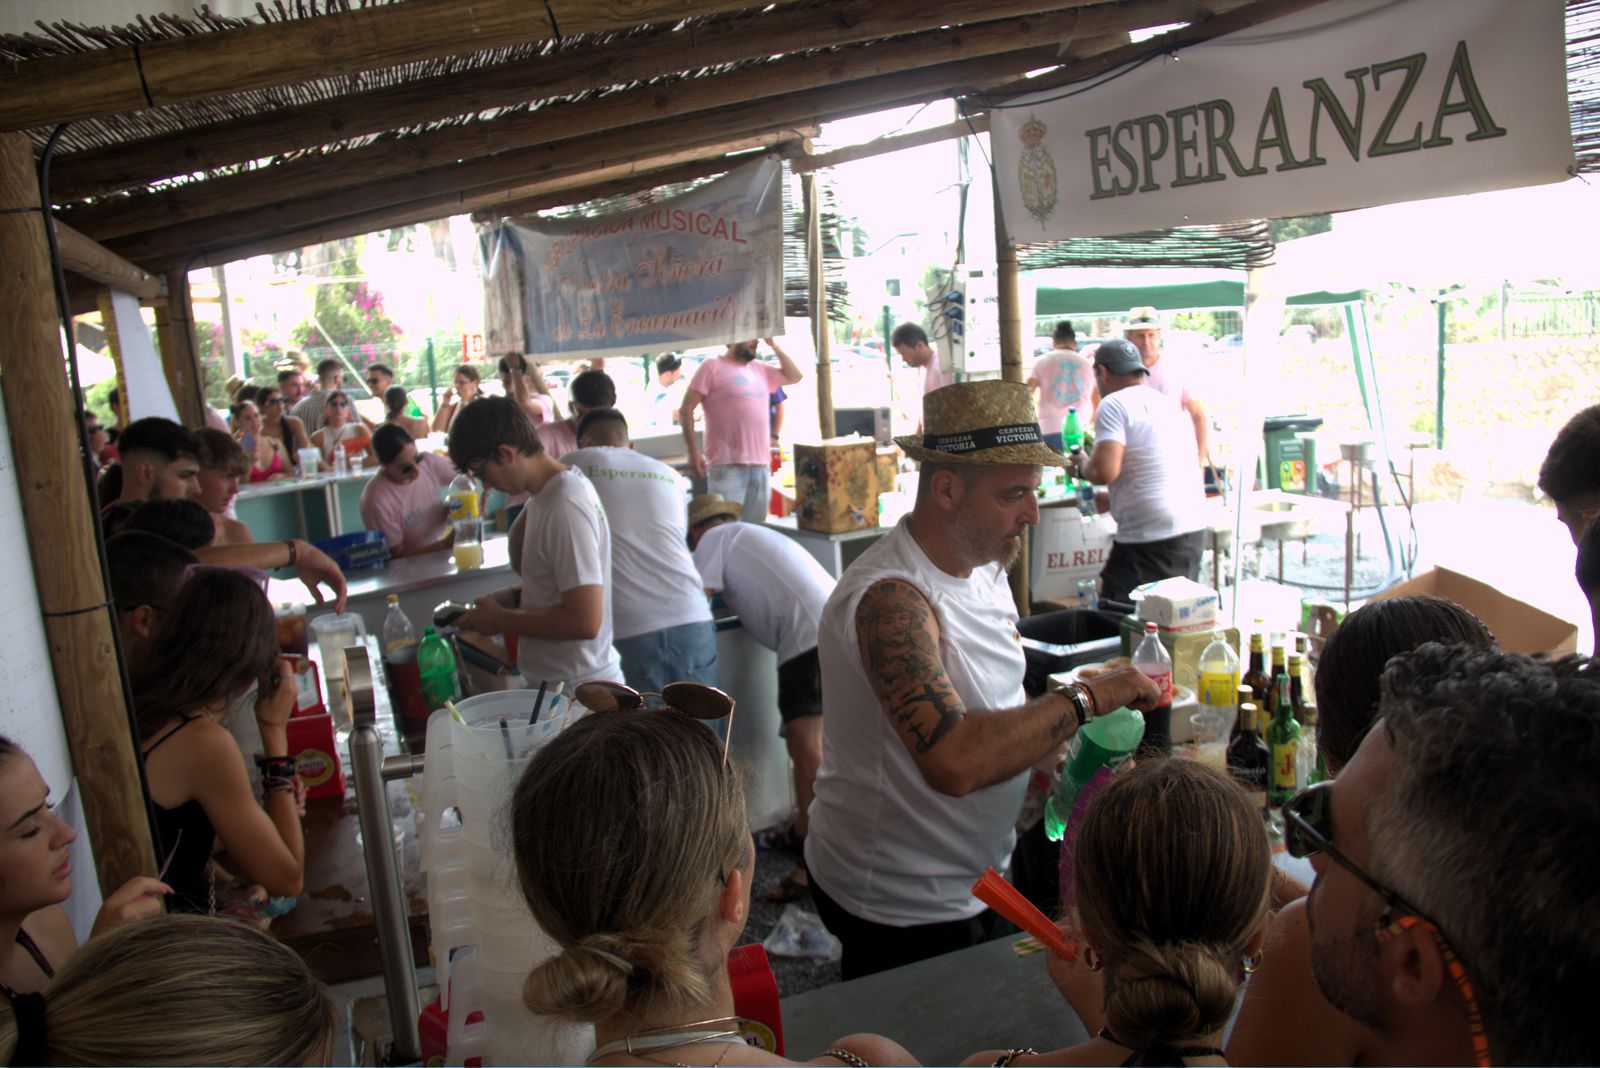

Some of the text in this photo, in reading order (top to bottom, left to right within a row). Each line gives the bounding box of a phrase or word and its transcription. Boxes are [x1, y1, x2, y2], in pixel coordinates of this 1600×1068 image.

[1084, 40, 1507, 200] ESPERANZA
[639, 208, 748, 244] MUSICAL
[996, 432, 1038, 444] VICTORIA
[999, 426, 1034, 435] CERVEZAS
[936, 441, 976, 453] VICTORIA
[587, 465, 676, 486] Esperanza
[1047, 548, 1109, 569] EL REL
